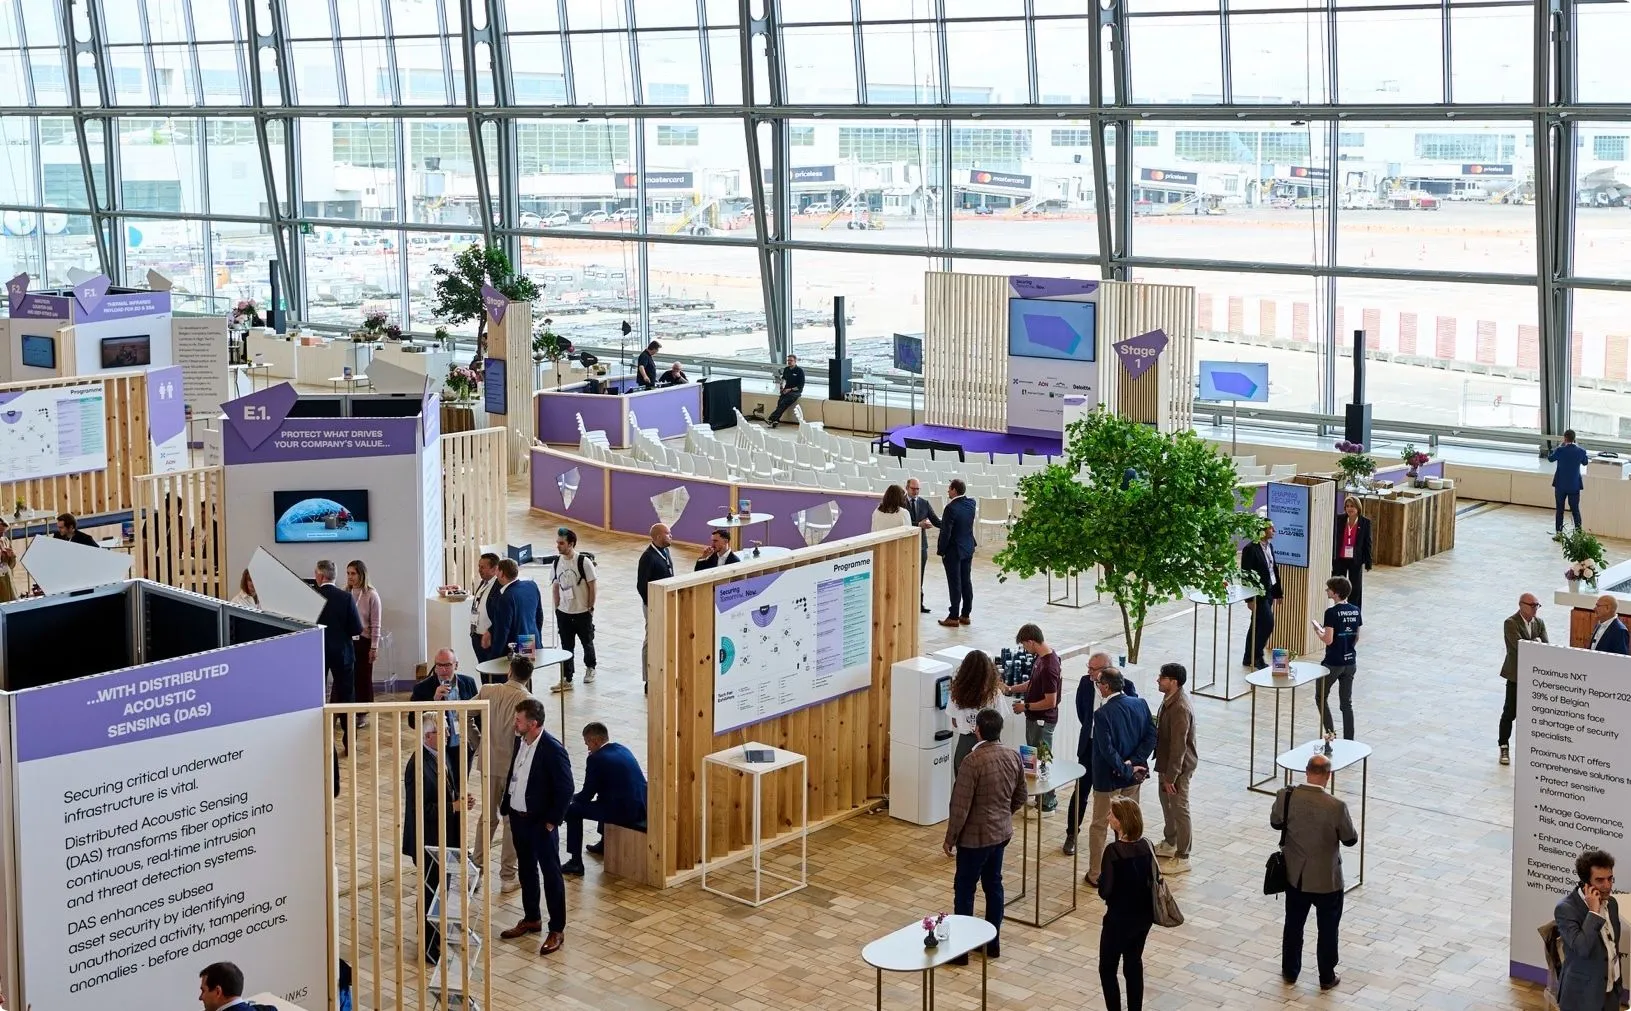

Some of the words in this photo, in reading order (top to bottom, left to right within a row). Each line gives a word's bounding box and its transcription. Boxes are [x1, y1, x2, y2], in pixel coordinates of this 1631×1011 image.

[84, 288, 97, 298] F.1.
[486, 296, 505, 307] Stage
[1120, 344, 1156, 358] Stage
[1135, 359, 1140, 368] 1
[244, 406, 271, 420] E.1.
[352, 430, 383, 438] DRIVES
[355, 440, 390, 448] VALUE...
[834, 559, 871, 572] Programme
[720, 587, 740, 596] Securing
[1532, 666, 1568, 679] Proximus
[1570, 672, 1588, 681] NXT
[86, 683, 136, 705] ...WITH
[139, 663, 229, 694] DISTRIBUTED
[1532, 679, 1586, 696] Cybersecurity
[1588, 688, 1616, 699] Report
[1617, 693, 1631, 702] 202
[123, 688, 196, 715] ACOUSTIC
[1532, 691, 1548, 701] 39%
[1560, 696, 1590, 708] Belgian
[108, 713, 170, 737] SENSING
[174, 702, 212, 724] (DAS)
[1532, 705, 1585, 720] organizations
[1587, 713, 1605, 723] face
[1531, 730, 1573, 743] specialists.
[1539, 718, 1575, 731] shortage
[1587, 727, 1619, 740] security
[1530, 746, 1566, 760] Proximus
[1568, 754, 1585, 763] NXT
[1587, 758, 1611, 768] offers
[64, 780, 123, 803] Securing
[127, 767, 168, 787] critical
[172, 749, 244, 776] underwater
[1530, 760, 1588, 776] comprehensive
[1590, 770, 1625, 784] solutions
[1540, 776, 1568, 786] Protect
[1570, 781, 1605, 794] sensitive
[65, 791, 154, 824] infrastructure
[158, 788, 168, 799] is
[170, 778, 199, 795] vital.
[1540, 788, 1585, 801] information
[65, 820, 138, 850] Distributed
[141, 806, 196, 829] Acoustic
[200, 791, 248, 813] Sensing
[1539, 804, 1572, 817] Manage
[1574, 811, 1624, 828] Governance,
[1540, 815, 1557, 826] Risk,
[1559, 820, 1574, 829] and
[1576, 823, 1623, 839] Compliance
[66, 848, 103, 871] (DAS)
[107, 829, 178, 858] transforms
[181, 821, 209, 837] fiber
[212, 808, 249, 831] optics
[251, 802, 273, 817] into
[1538, 833, 1573, 846] Enhance
[1575, 841, 1599, 851] Cyber
[67, 859, 143, 889] continuous,
[147, 841, 200, 866] real-time
[204, 826, 256, 850] intrusion
[1538, 844, 1577, 858] Resilience
[1528, 858, 1570, 873] Experience
[67, 892, 94, 909] and
[98, 880, 137, 900] threat
[142, 861, 200, 886] detection
[204, 844, 256, 868] systems.
[1528, 869, 1563, 883] Managed
[1527, 881, 1543, 890] with
[1546, 884, 1572, 895] Proxim
[68, 916, 97, 935] DAS
[100, 899, 164, 924] enhances
[168, 882, 214, 904] subsea
[69, 934, 106, 954] asset
[110, 917, 160, 941] security
[164, 910, 179, 924] by
[182, 890, 245, 920] identifying
[69, 937, 156, 974] unauthorized
[160, 921, 205, 945] activity,
[210, 900, 272, 928] tampering,
[275, 894, 288, 906] or
[70, 963, 138, 993] anomalies
[148, 946, 189, 967] before
[192, 928, 243, 952] damage
[246, 915, 288, 935] occurs.
[280, 986, 308, 1002] INKS
